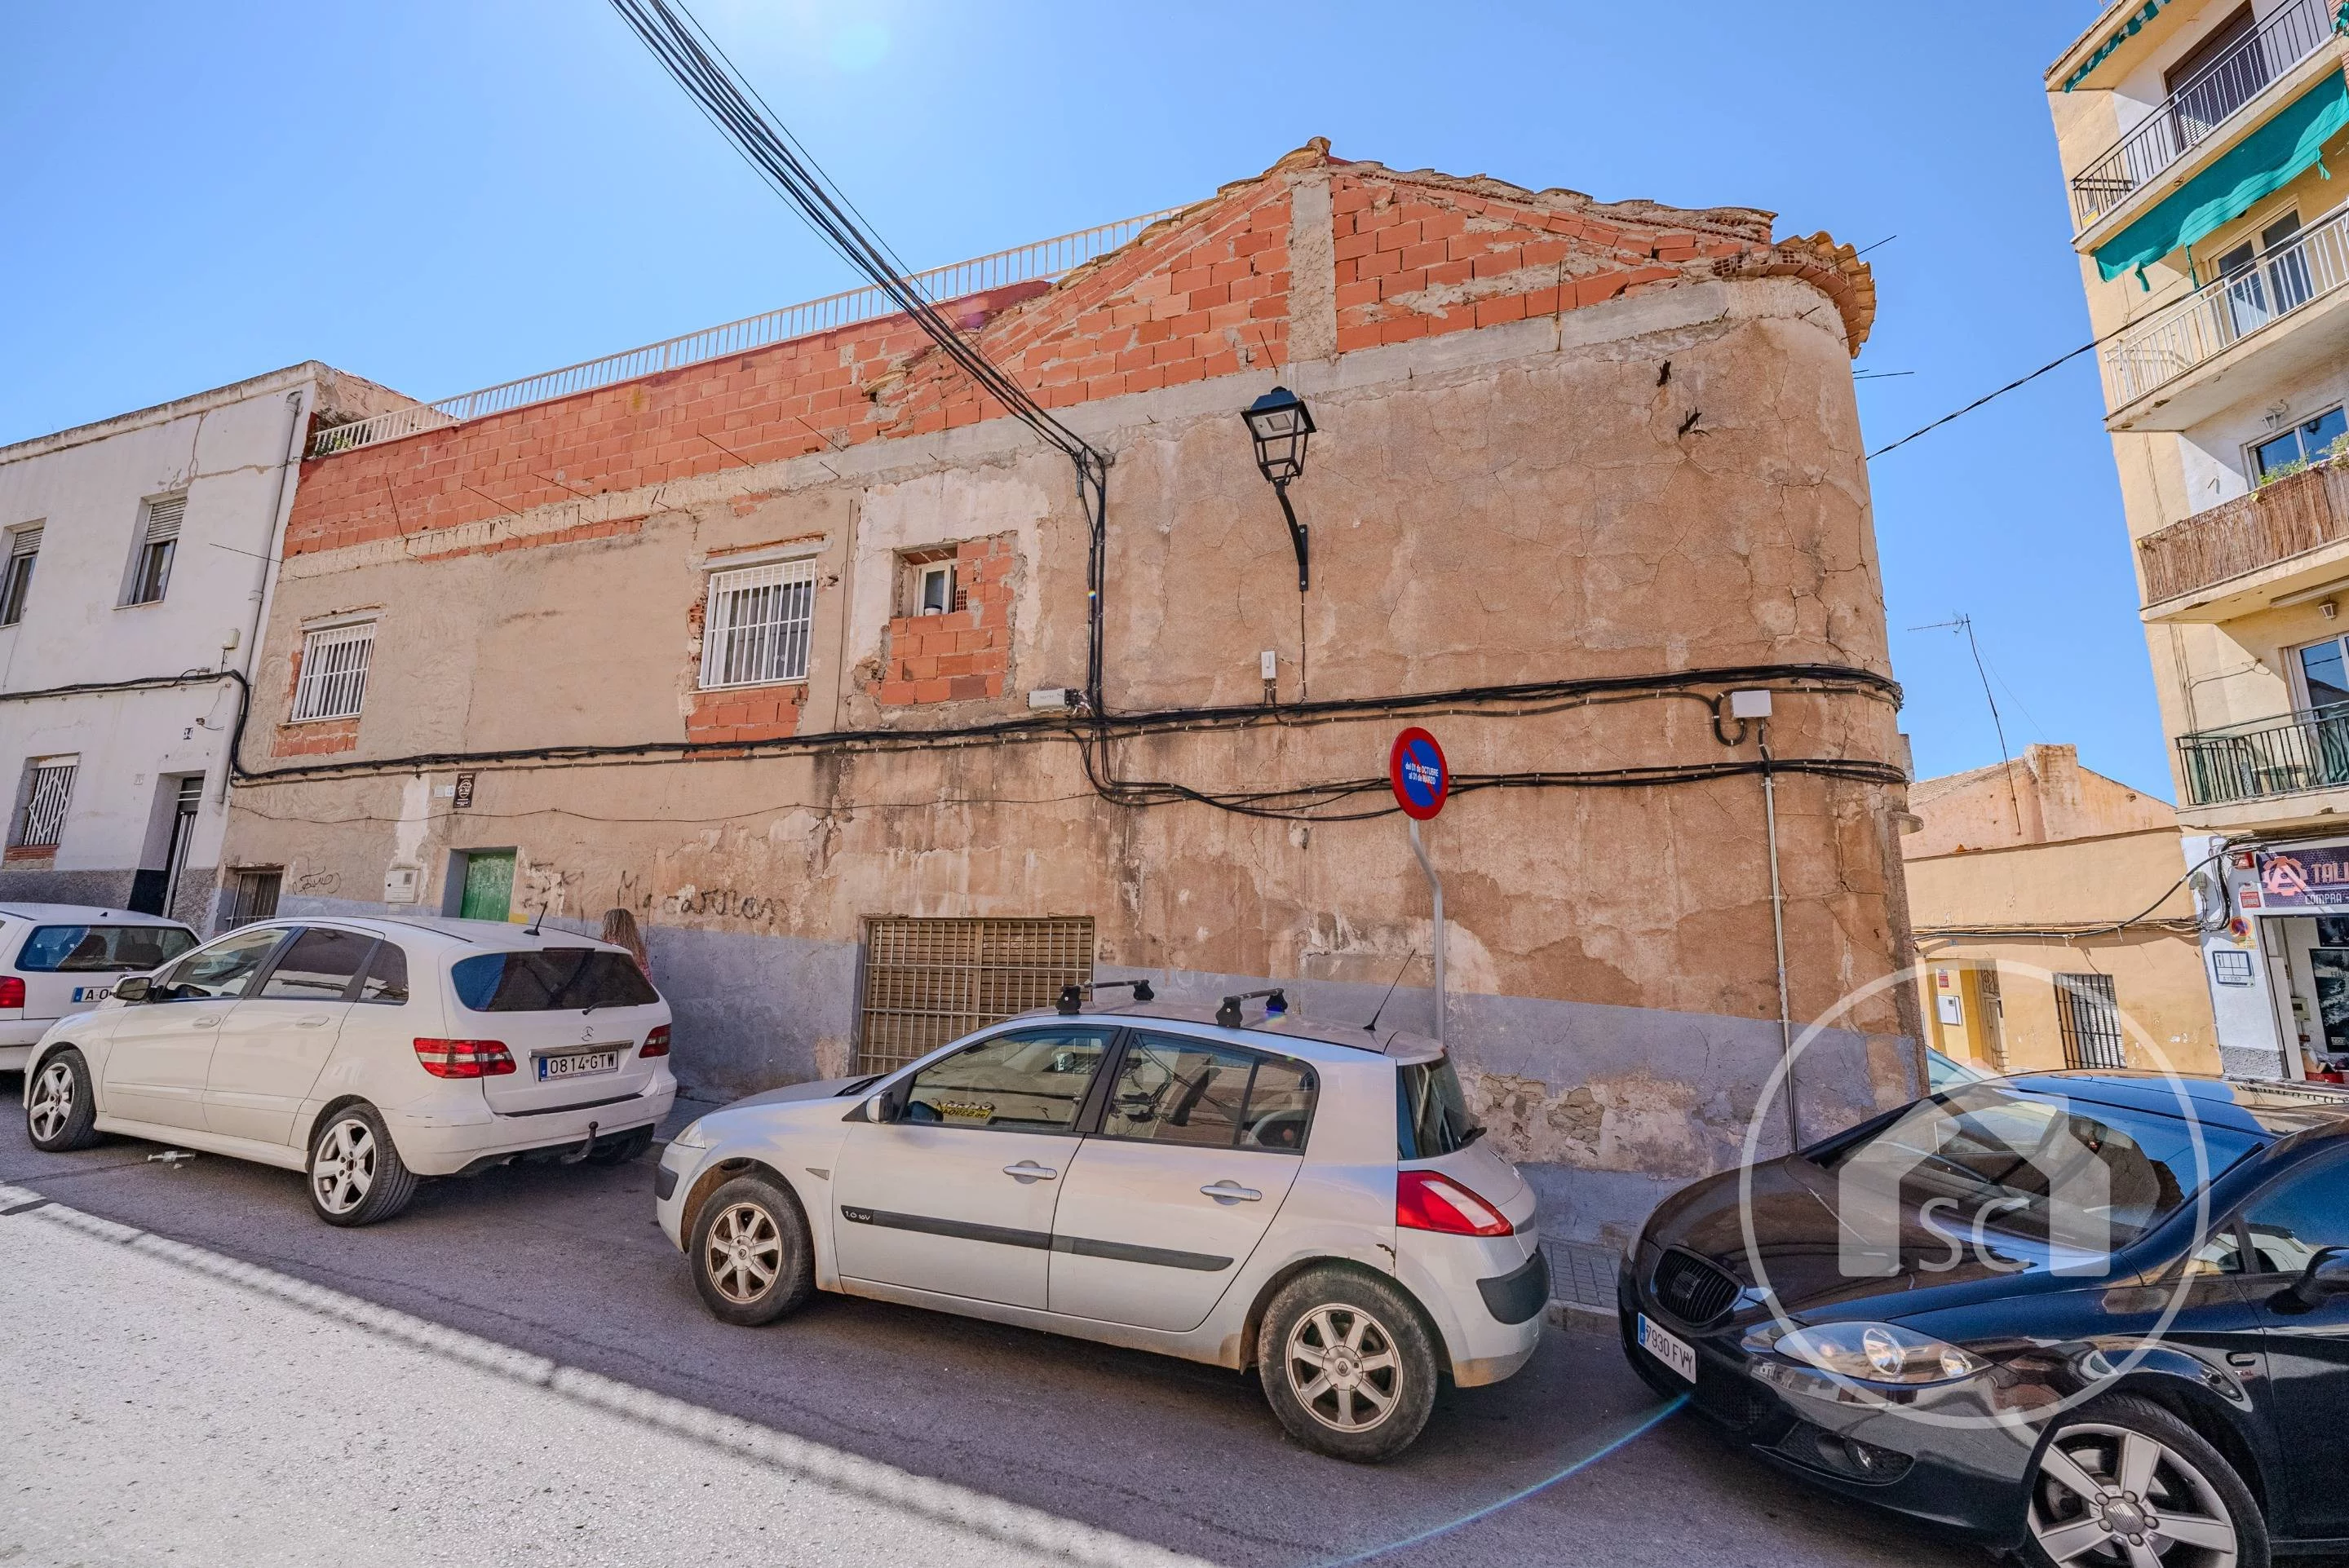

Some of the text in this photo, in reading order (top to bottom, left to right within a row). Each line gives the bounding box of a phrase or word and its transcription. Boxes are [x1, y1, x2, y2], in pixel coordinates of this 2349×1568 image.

[1422, 765, 1439, 777] OCTUBRE
[1422, 774, 1436, 784] MARZO
[2305, 893, 2342, 905] COMPRA
[550, 1053, 615, 1074] 0814 GTW
[1645, 1324, 1693, 1373] 7930 FVY
